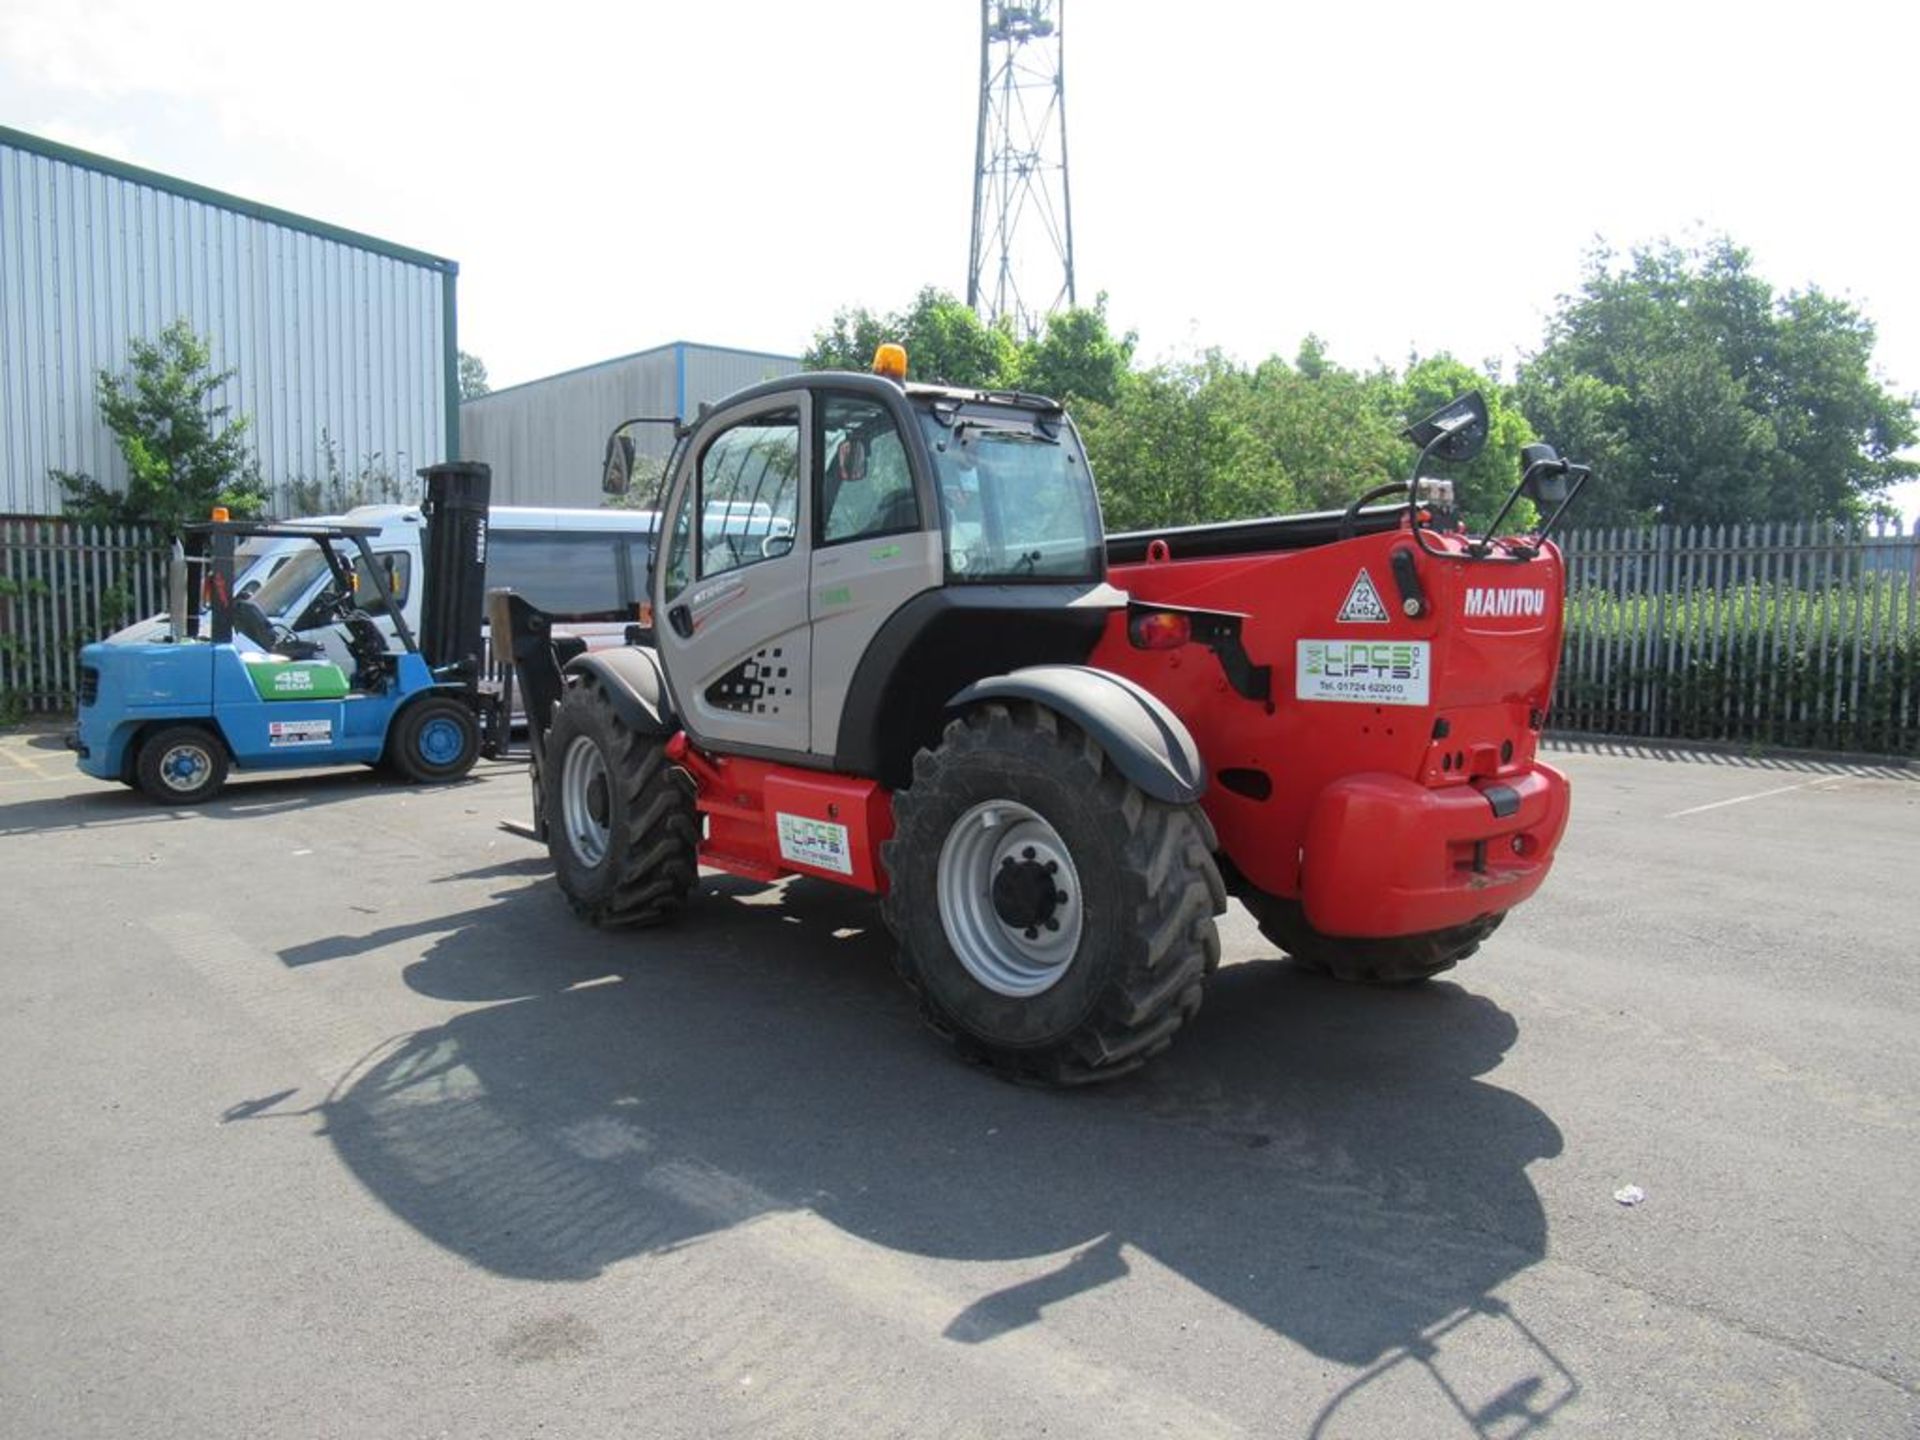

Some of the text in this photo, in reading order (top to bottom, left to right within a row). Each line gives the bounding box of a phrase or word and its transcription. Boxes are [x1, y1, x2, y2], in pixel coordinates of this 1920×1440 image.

[1357, 588, 1370, 603] 22
[1464, 588, 1544, 617] MANITOU
[1325, 664, 1411, 680] LIFTS
